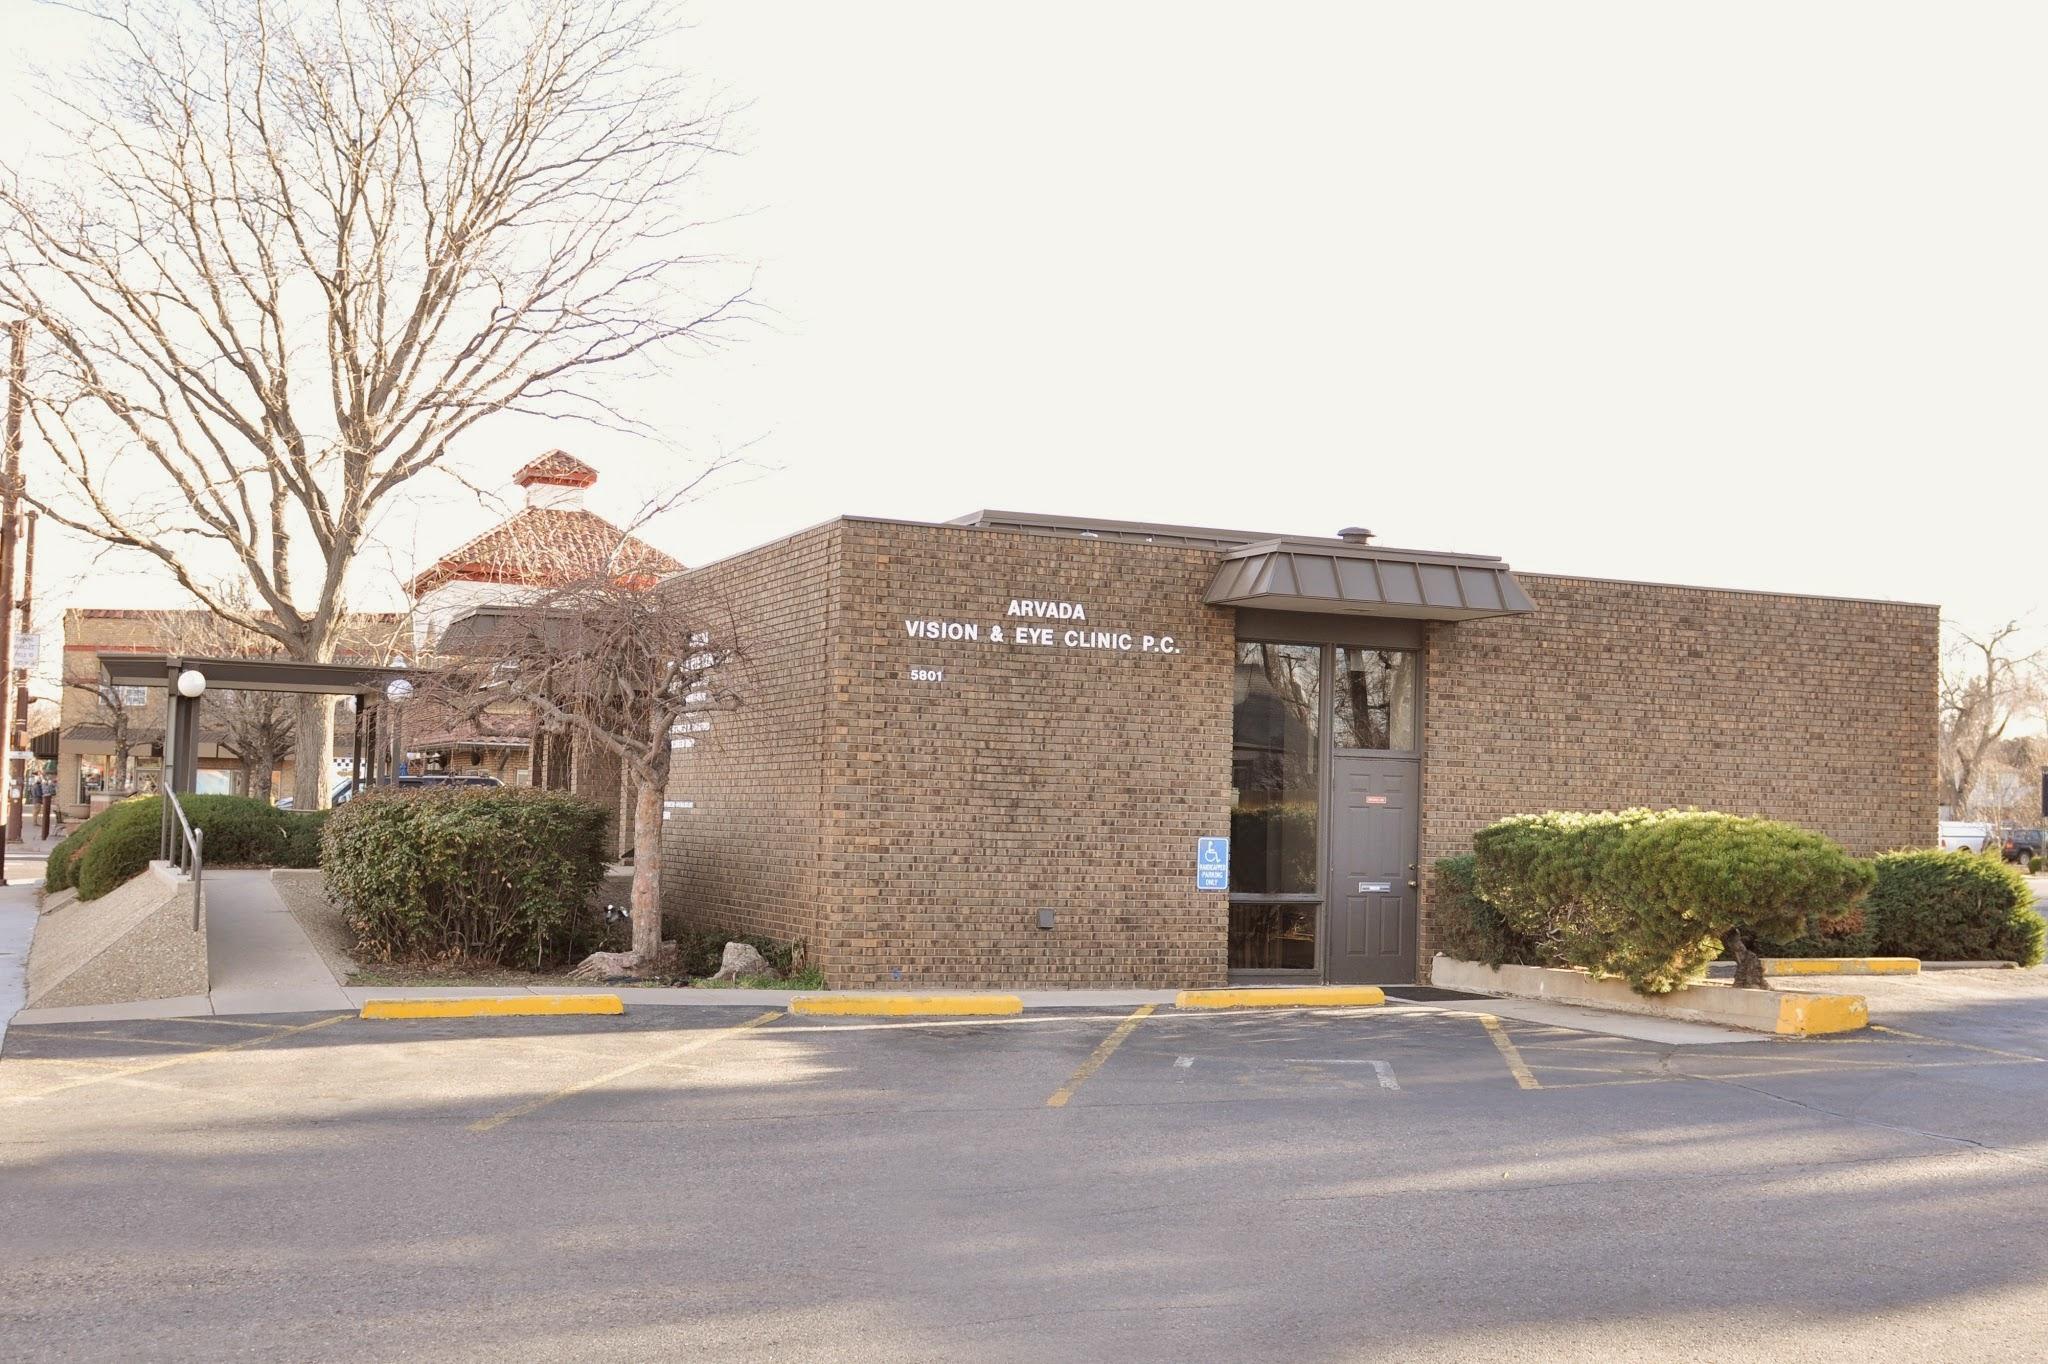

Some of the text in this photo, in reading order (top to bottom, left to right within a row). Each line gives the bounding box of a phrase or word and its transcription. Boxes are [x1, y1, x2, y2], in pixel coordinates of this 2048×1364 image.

[1007, 599, 1086, 620] ARVADA
[905, 620, 1180, 653] VISION & EYE CLINIC P.C.
[910, 669, 942, 681] 5801
